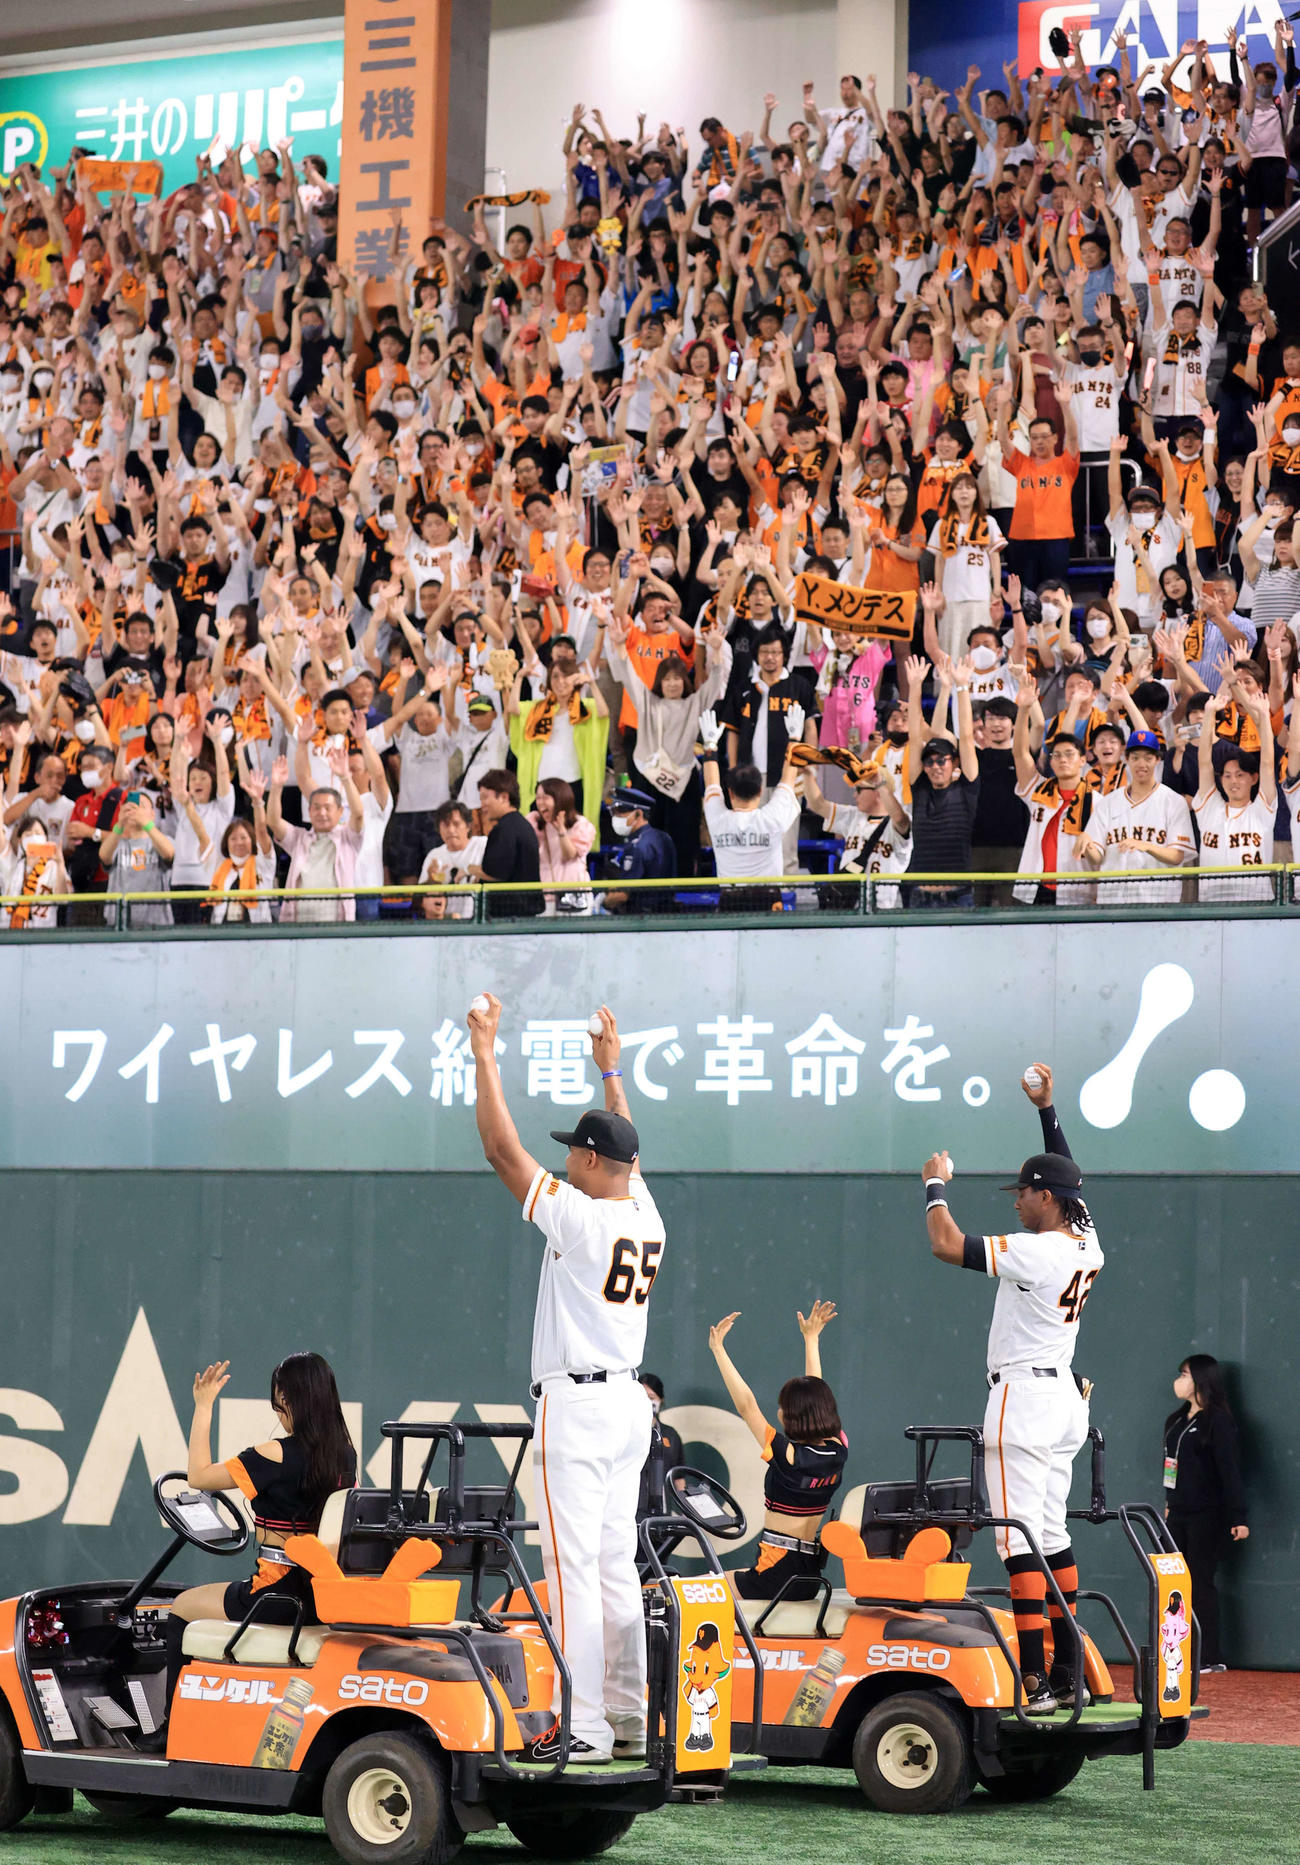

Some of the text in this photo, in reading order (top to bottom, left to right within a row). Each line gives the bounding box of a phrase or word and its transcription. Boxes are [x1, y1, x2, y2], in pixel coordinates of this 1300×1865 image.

[1180, 283, 1195, 296] 20
[1187, 361, 1202, 374] 88
[1095, 396, 1111, 409] 24
[967, 552, 984, 567] 25
[853, 692, 862, 707] 6
[655, 772, 676, 791] 22
[602, 1237, 662, 1306] 65
[676, 1582, 727, 1605] sato
[866, 1643, 951, 1671] sato
[338, 1674, 429, 1707] sato
